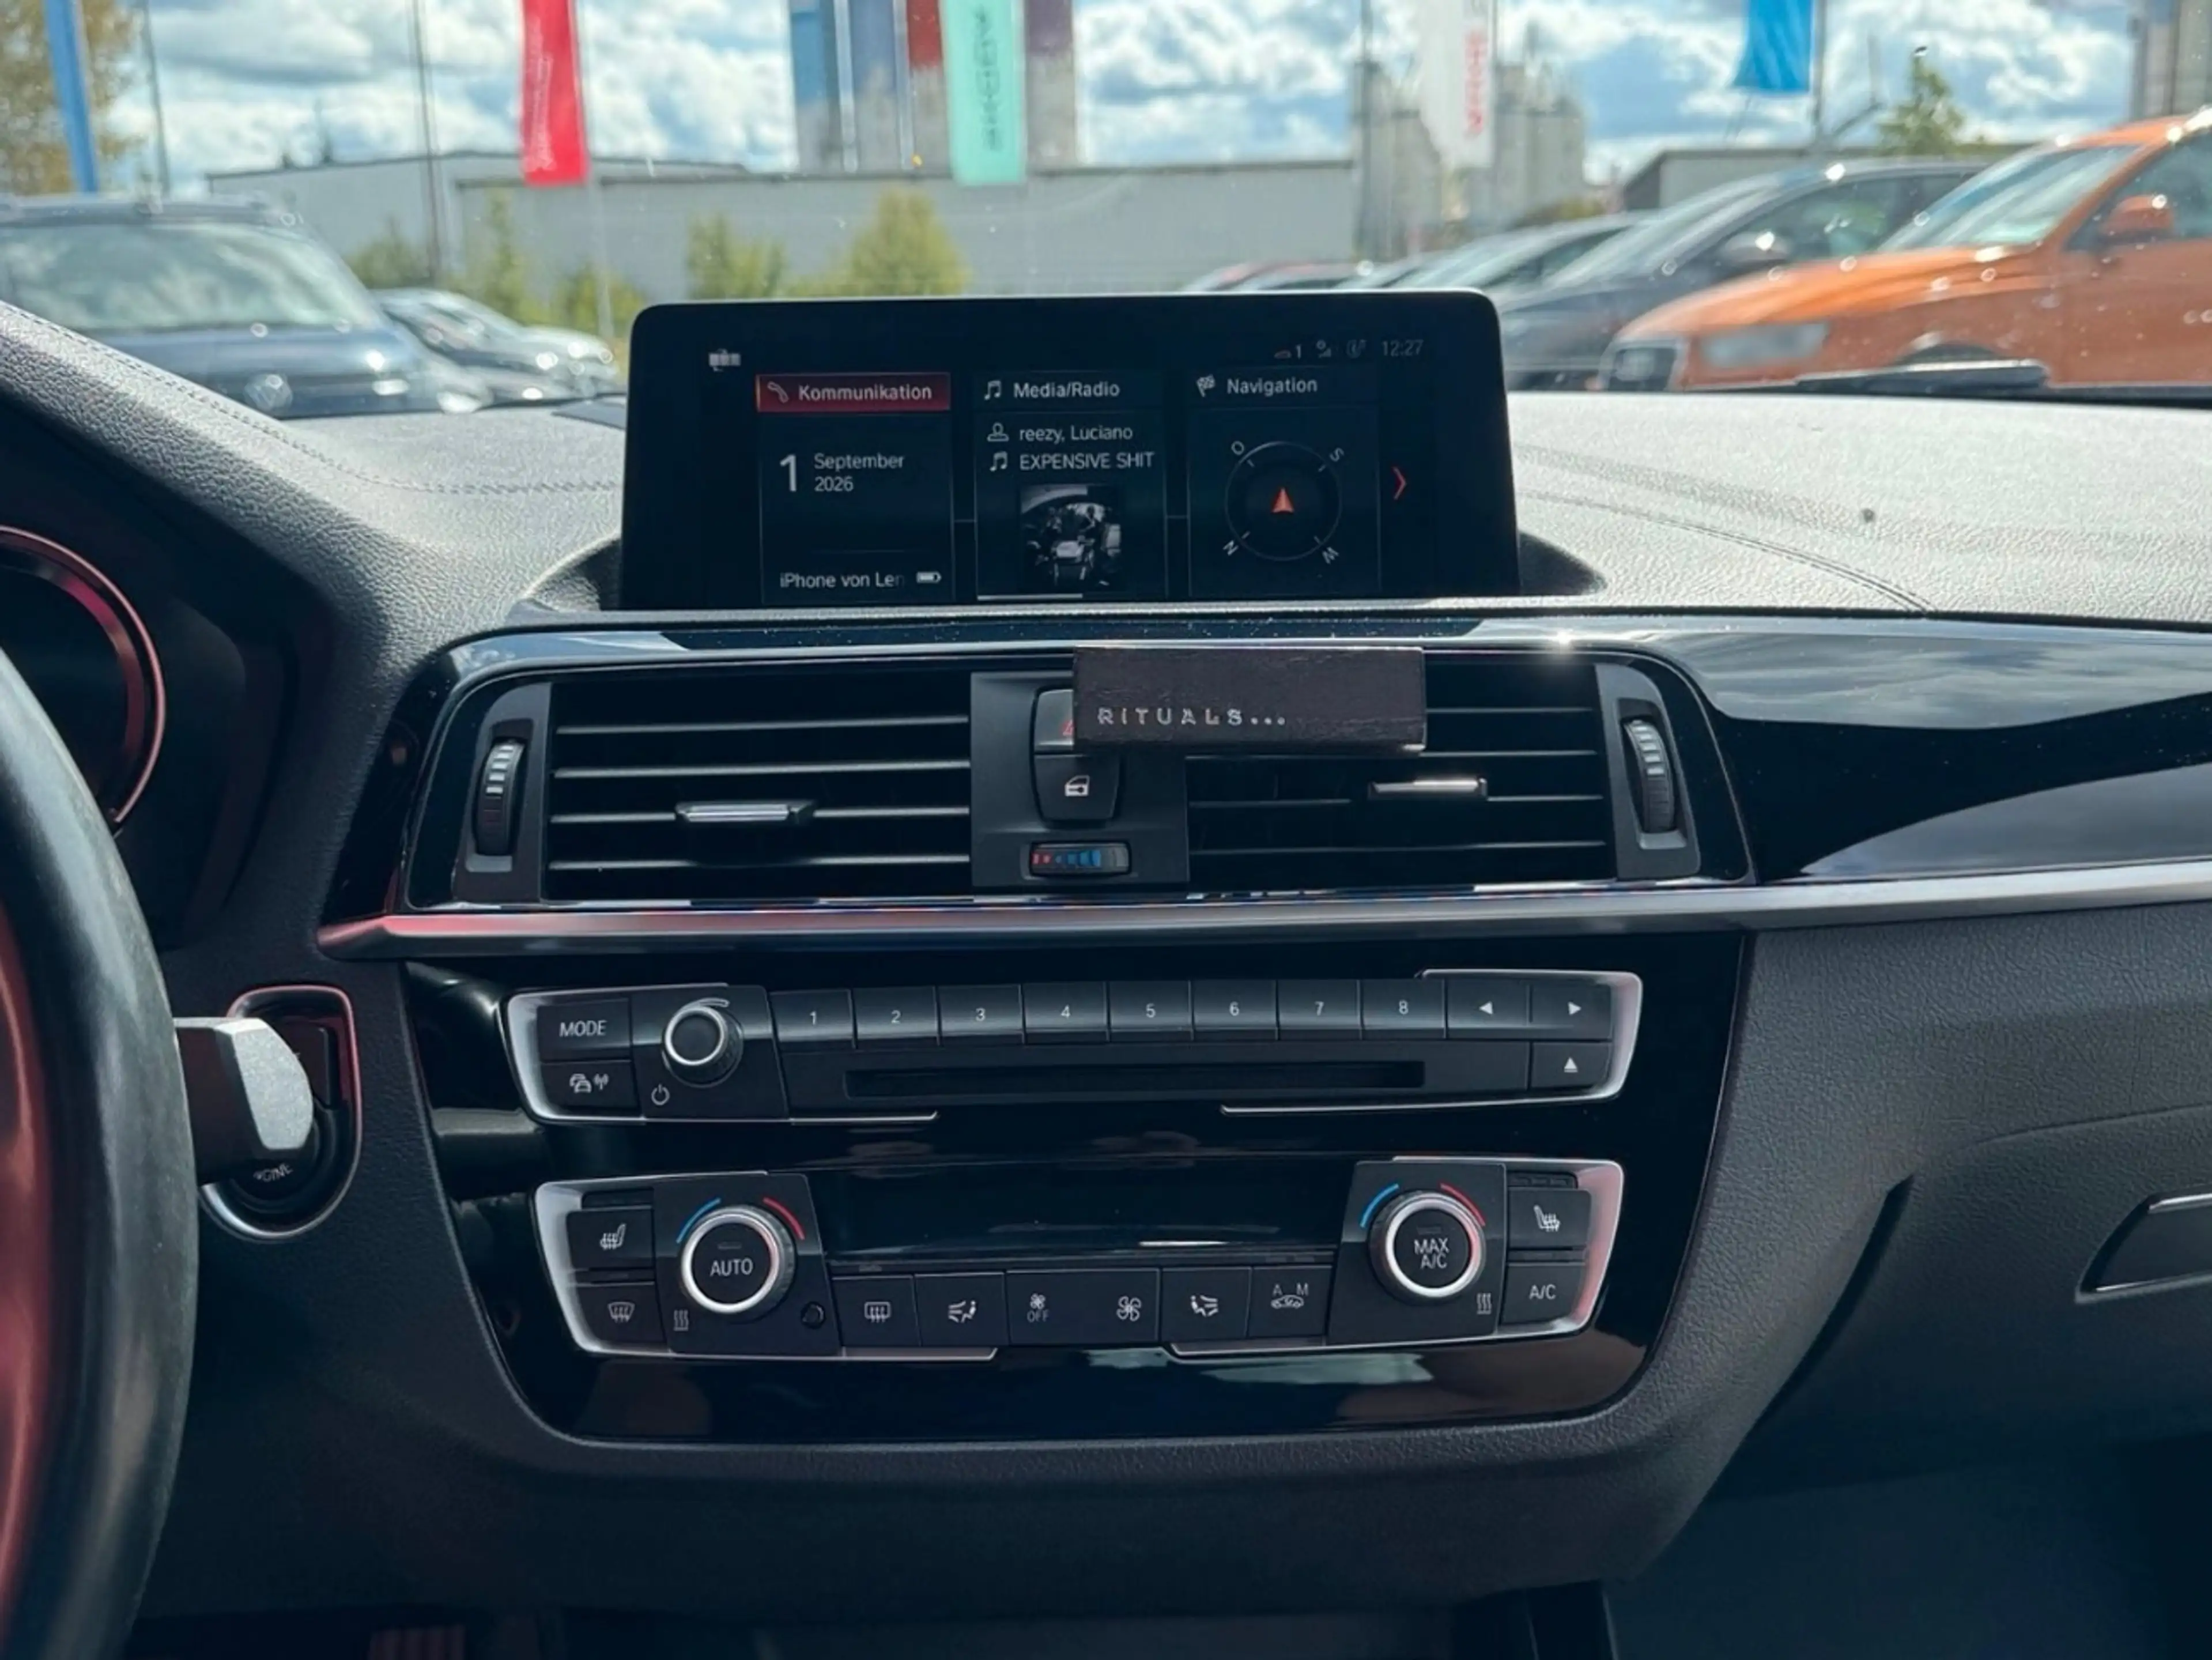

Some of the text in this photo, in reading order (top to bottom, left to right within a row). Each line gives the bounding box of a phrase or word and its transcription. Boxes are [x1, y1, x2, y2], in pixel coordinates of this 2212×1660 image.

[1382, 339, 1424, 357] 12:27
[798, 384, 933, 401] Kommunikation
[1013, 382, 1120, 398] Media/Radio
[1227, 376, 1318, 397] Navigation
[1020, 425, 1133, 444] reezy, Luciano
[1231, 441, 1245, 455] O
[1330, 447, 1344, 462] S
[813, 452, 905, 471] September
[1020, 451, 1154, 470] EXPENSIVE SHIT
[780, 454, 797, 492] 1
[814, 476, 854, 493] 2026
[780, 572, 837, 588] iPhone
[841, 574, 870, 587] von
[975, 1008, 986, 1022] 3
[1061, 1005, 1071, 1019] 4
[1145, 1003, 1156, 1018] 5
[1229, 1002, 1240, 1016] 6
[1314, 1001, 1324, 1015] 7
[1398, 1000, 1409, 1015] 8
[810, 1011, 817, 1025] 1
[891, 1010, 901, 1024] 2
[559, 1020, 607, 1037] MODE
[1414, 1238, 1449, 1255] MAX
[709, 1258, 754, 1277] AUTO
[1420, 1252, 1448, 1269] A/C
[1273, 1282, 1309, 1296] A M
[1529, 1284, 1557, 1300] A/C
[1026, 1310, 1049, 1323] OFF
